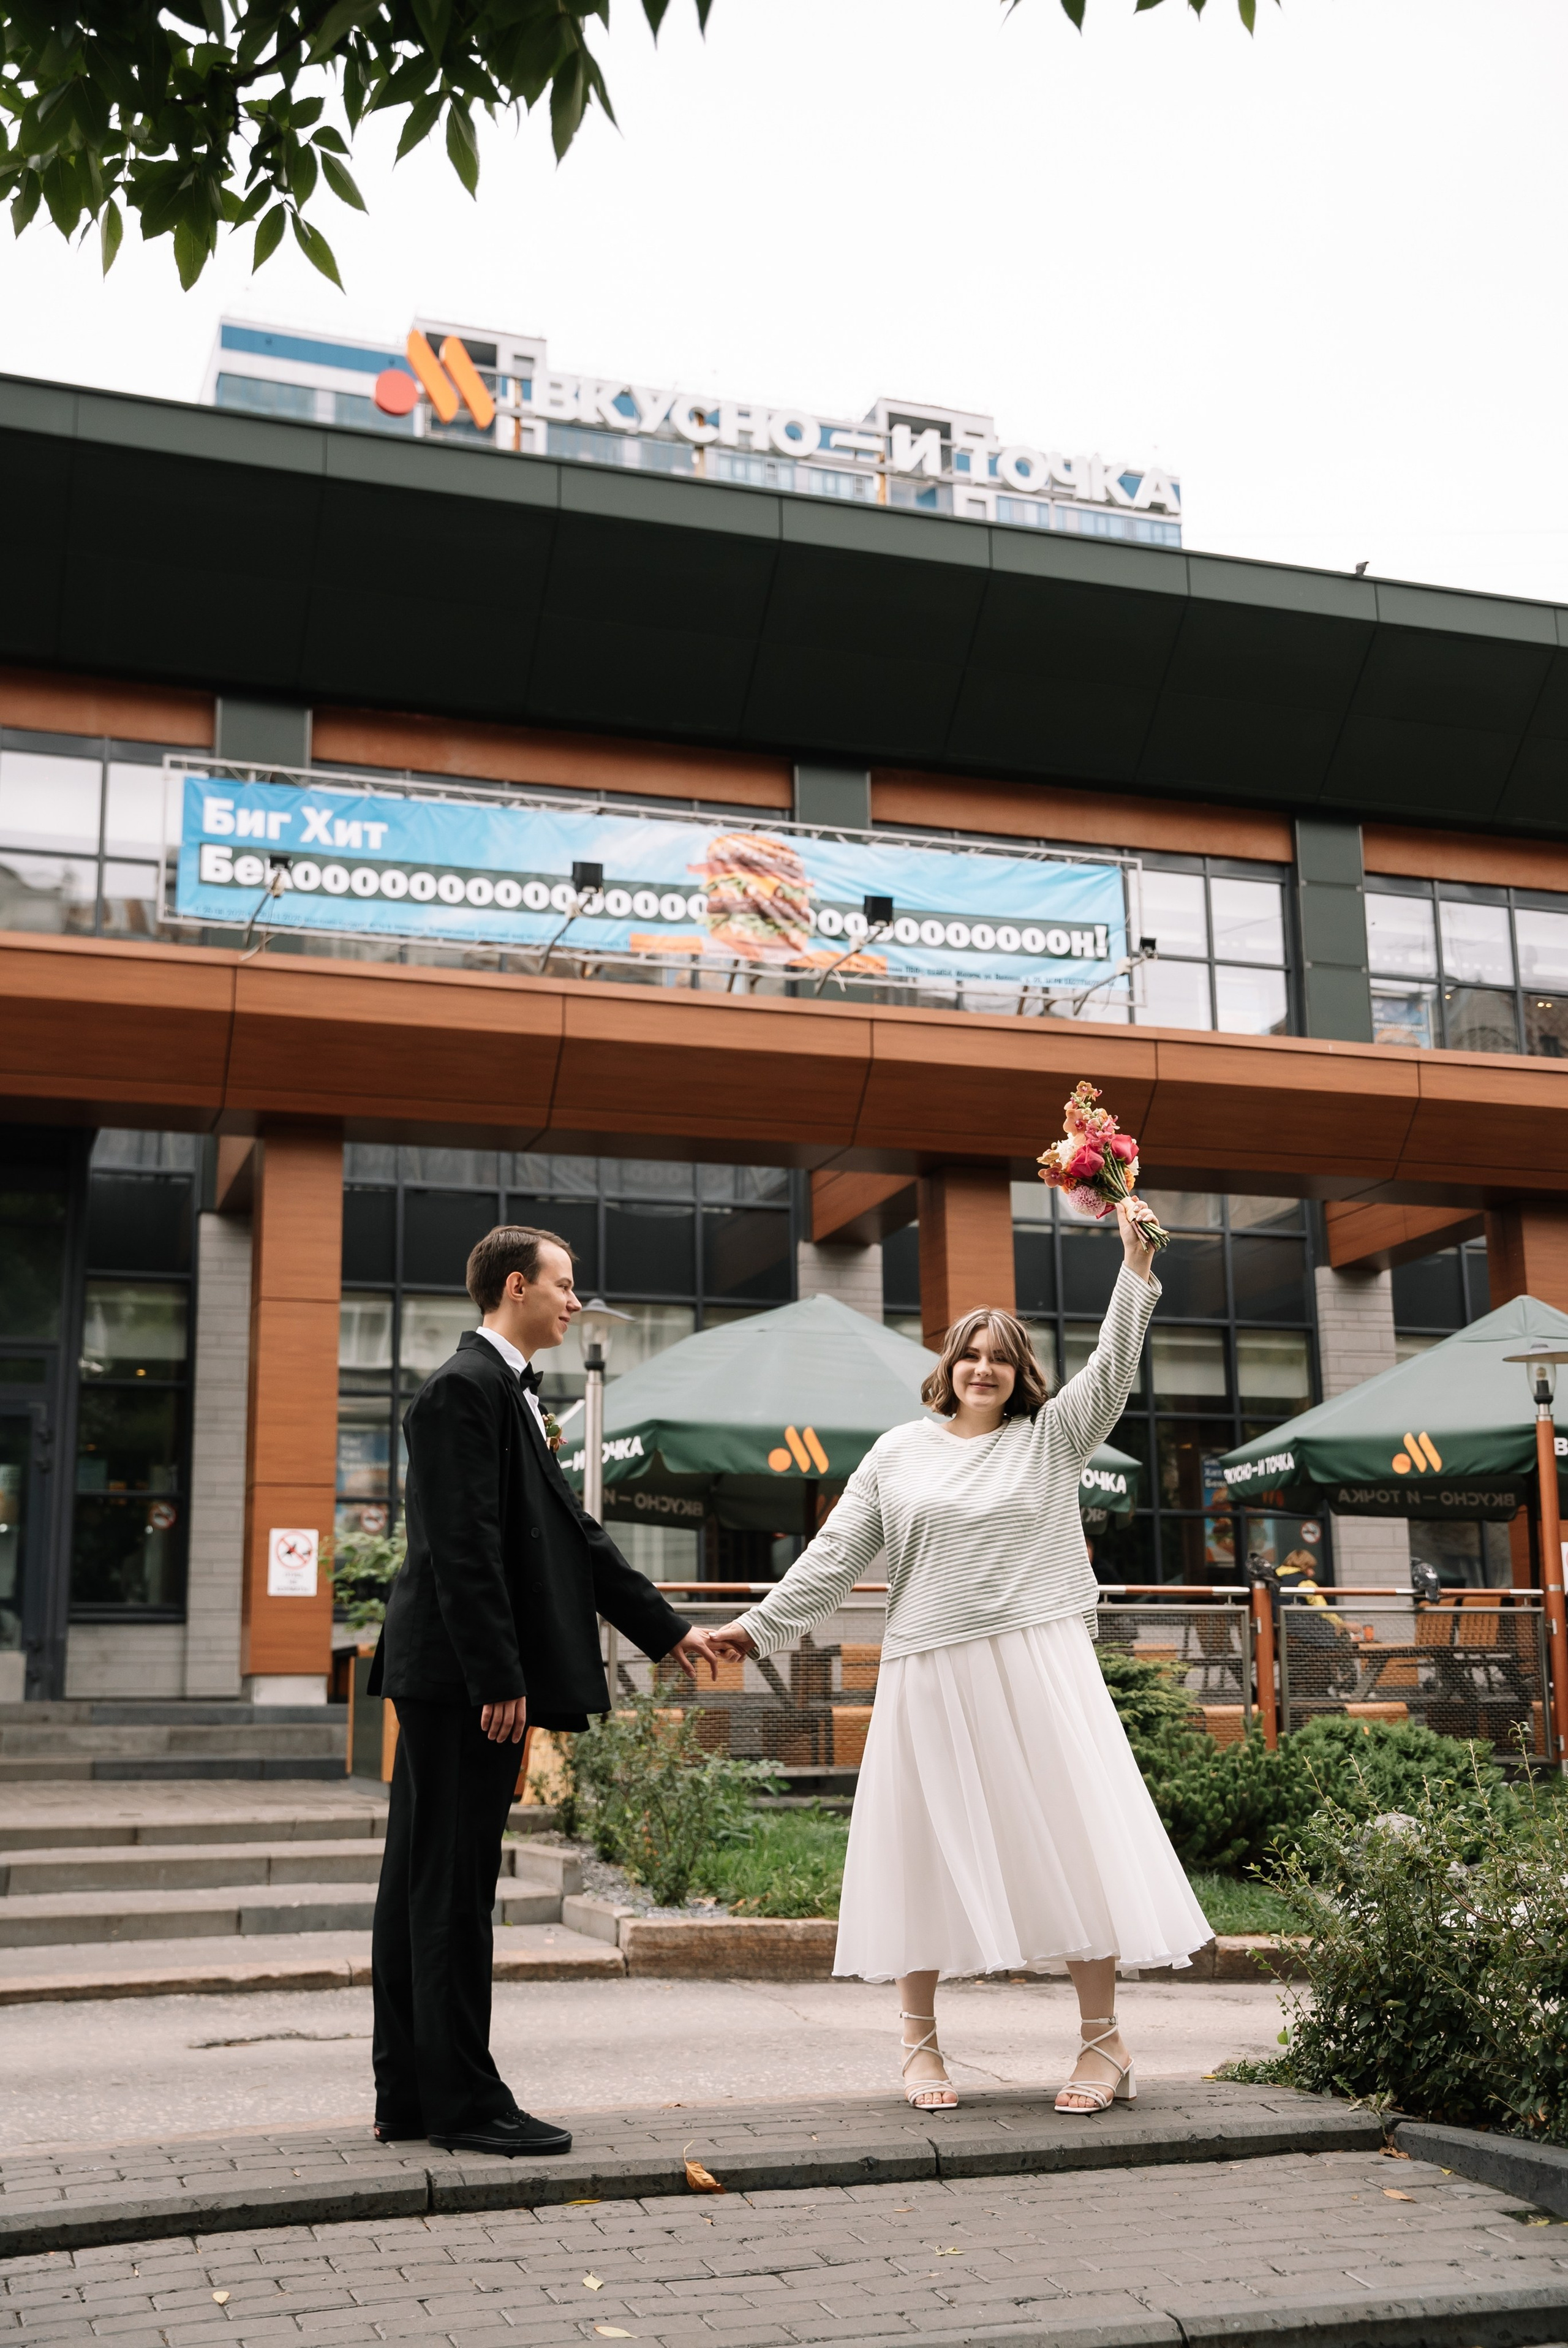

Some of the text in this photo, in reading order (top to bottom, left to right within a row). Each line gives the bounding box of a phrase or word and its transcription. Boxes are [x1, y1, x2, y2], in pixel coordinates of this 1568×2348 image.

[532, 371, 821, 458] ВКУСНО
[956, 429, 1181, 515] ТОЧКА
[202, 795, 389, 850] Биг Хит
[1081, 1468, 1127, 1494] ОЧКА
[1265, 1452, 1295, 1474] ТОЧКА
